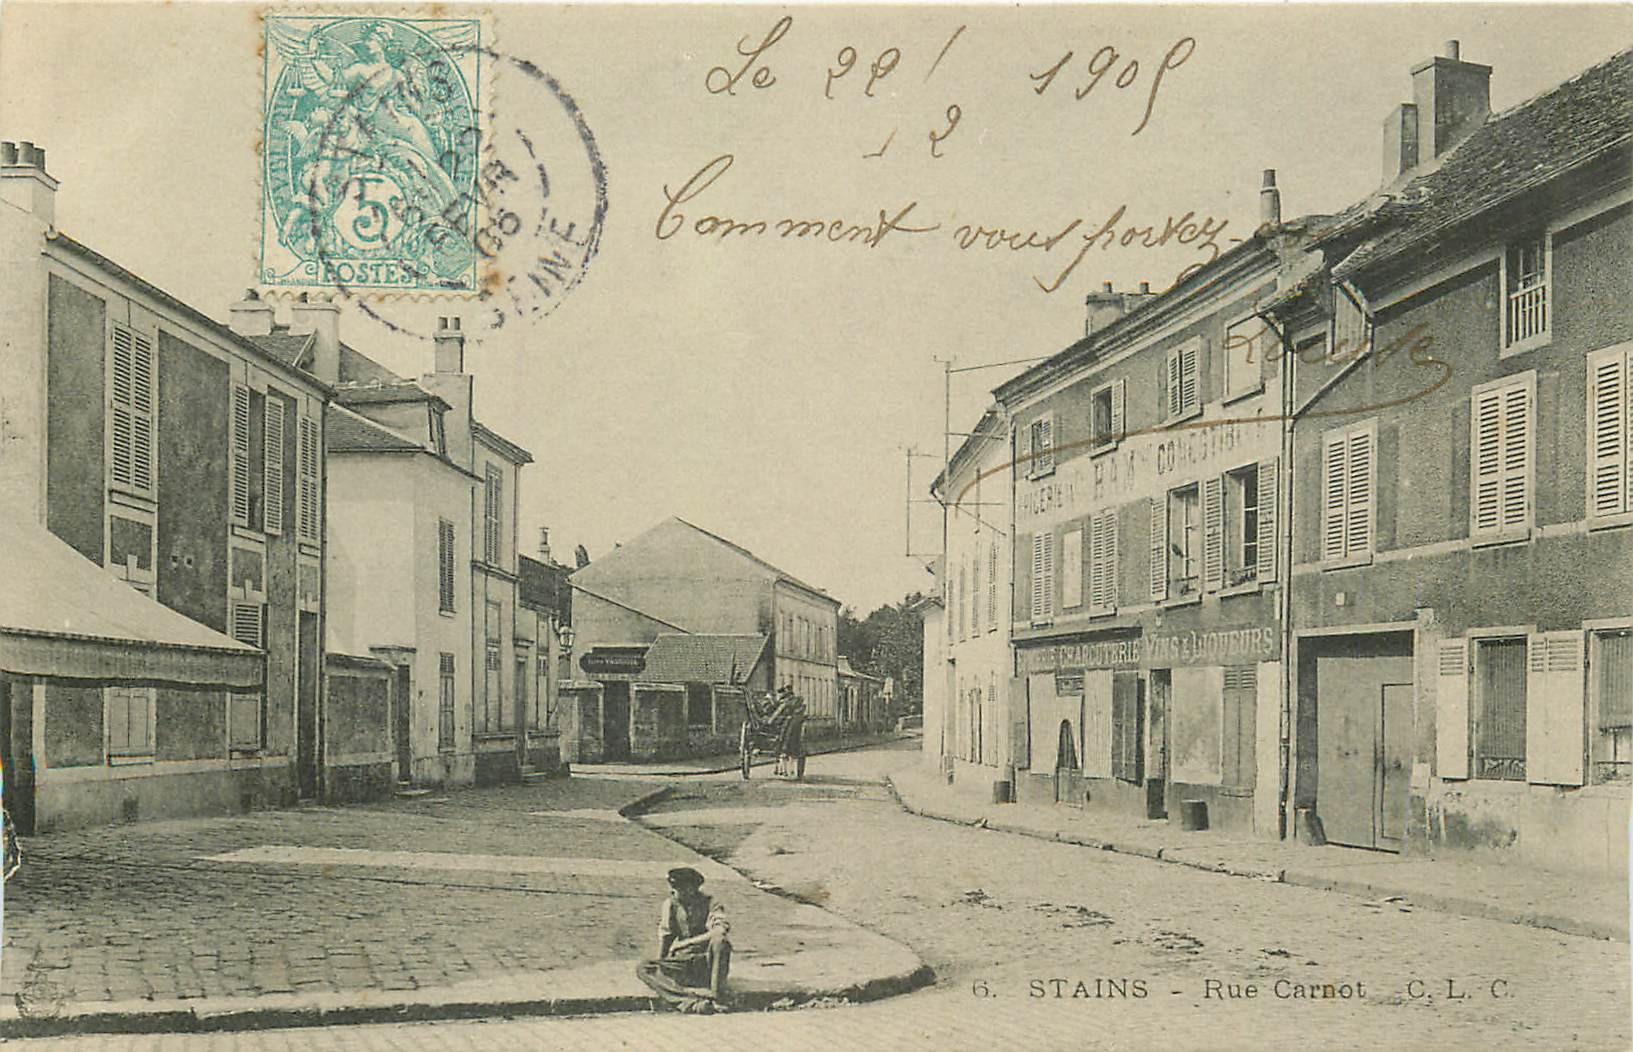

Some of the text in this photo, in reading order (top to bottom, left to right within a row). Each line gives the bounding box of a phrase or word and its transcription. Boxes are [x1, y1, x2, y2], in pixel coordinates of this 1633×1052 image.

[705, 15, 793, 96] Le
[1030, 37, 1196, 136] 1905
[656, 154, 941, 248] Comment
[953, 218, 1083, 252] vous
